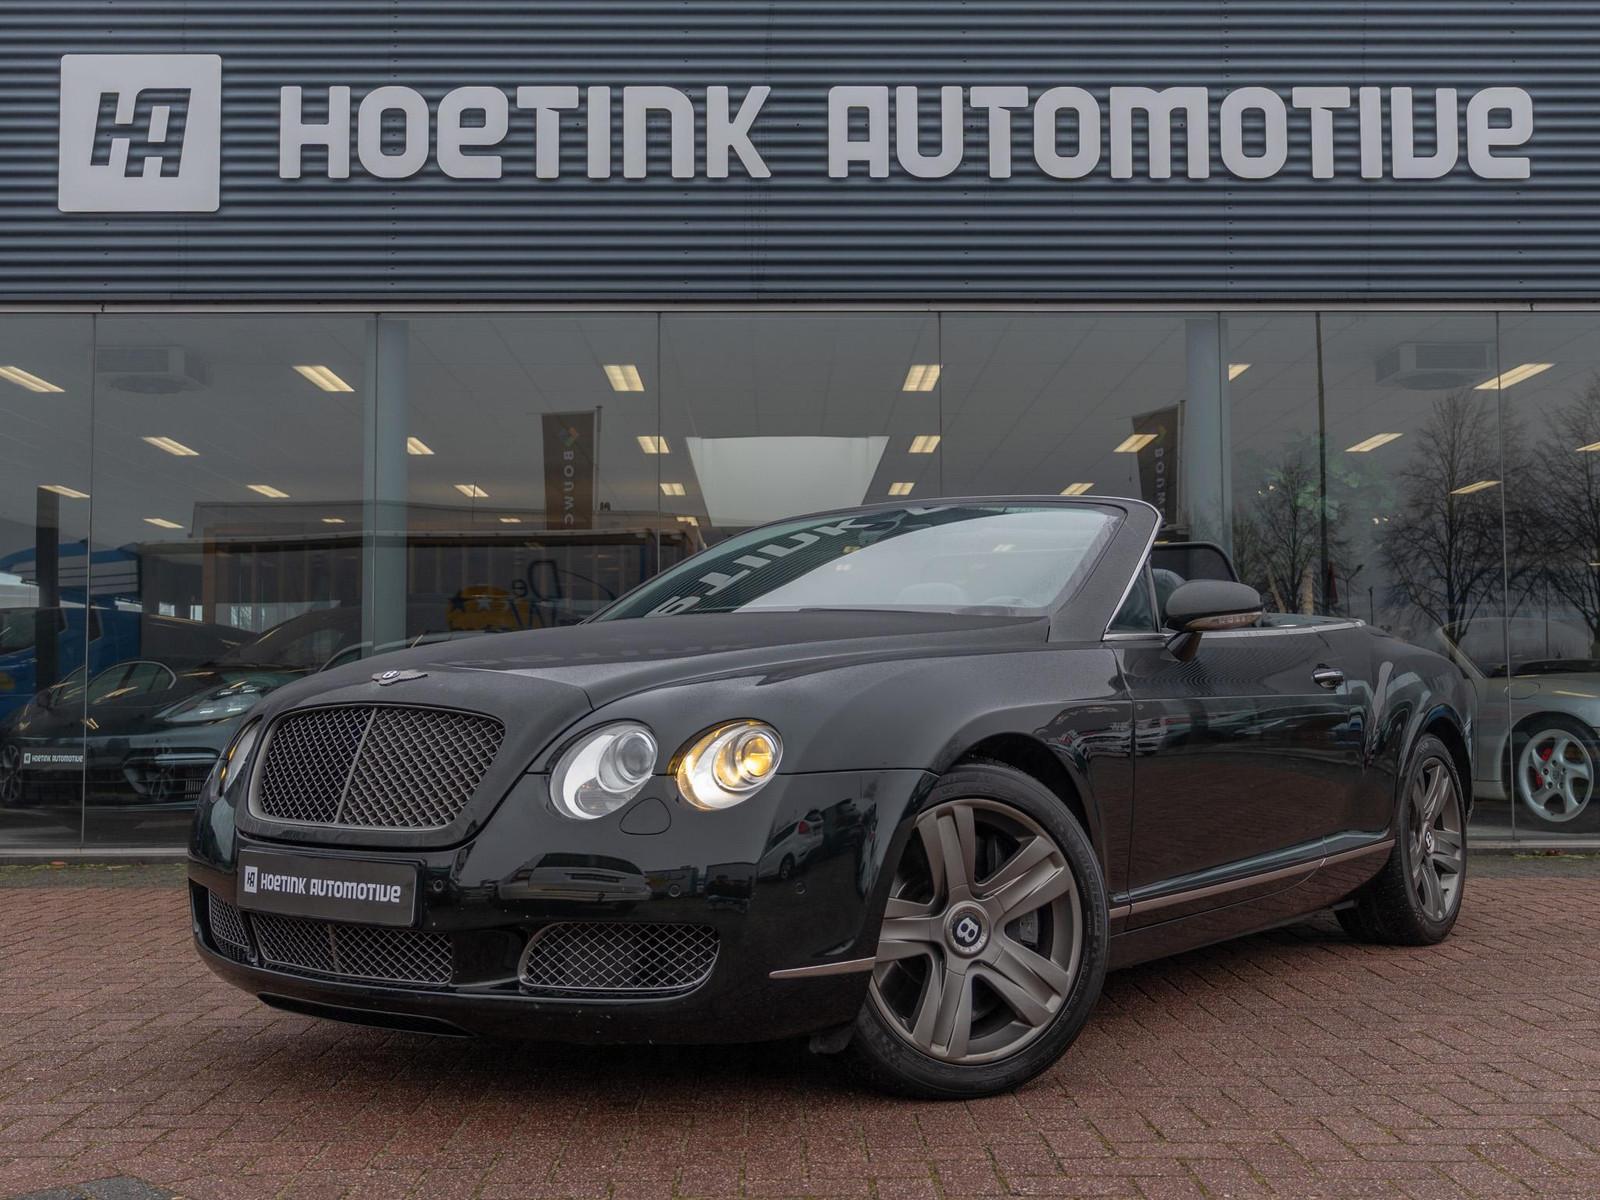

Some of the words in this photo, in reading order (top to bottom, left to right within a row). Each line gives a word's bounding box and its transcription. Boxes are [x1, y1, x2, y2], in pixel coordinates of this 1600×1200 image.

[828, 86, 1533, 179] AUTOMOTIVE
[260, 872, 307, 895] HOETINK
[309, 878, 401, 903] AUTOMOTIVE
